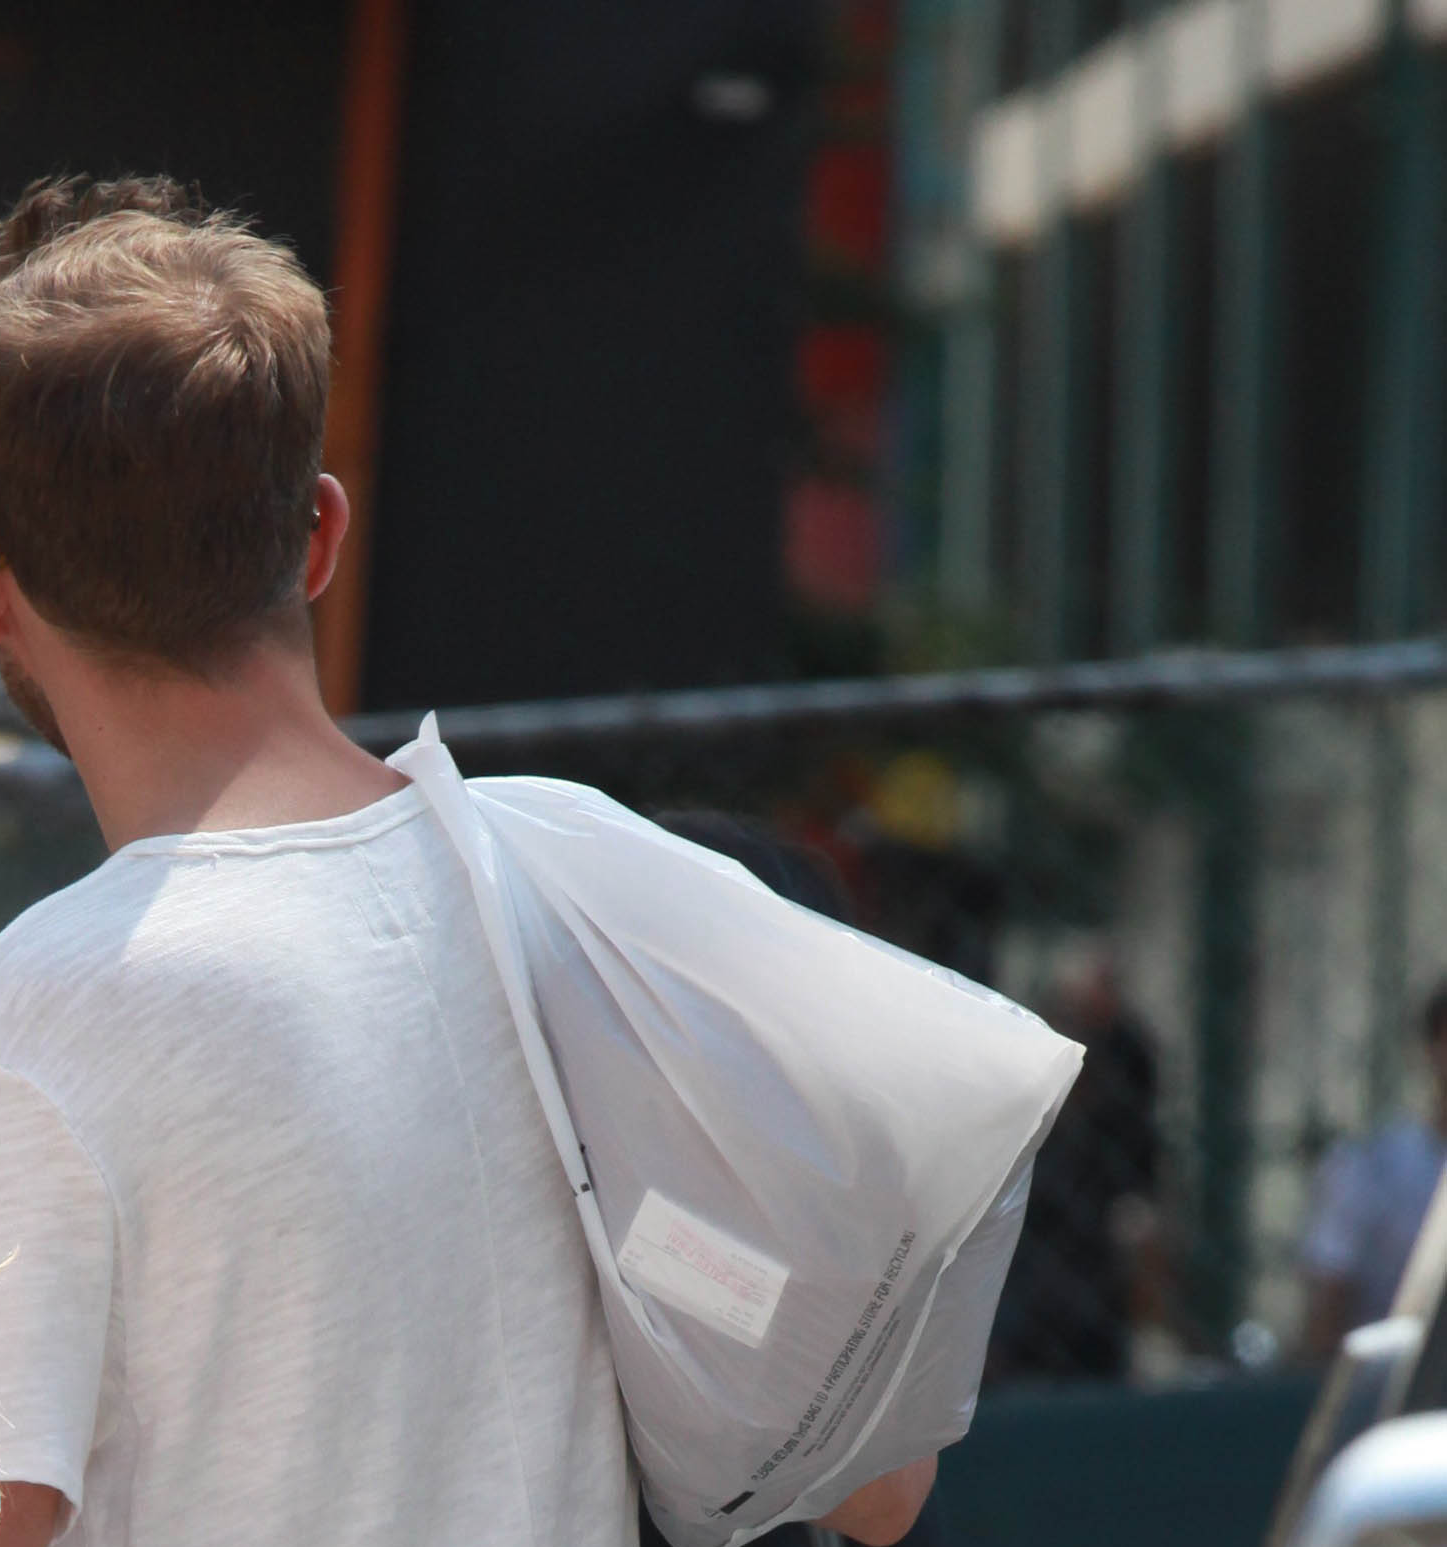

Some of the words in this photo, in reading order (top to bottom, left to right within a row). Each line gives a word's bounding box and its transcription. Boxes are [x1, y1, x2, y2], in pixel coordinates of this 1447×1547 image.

[803, 1402, 822, 1422] BAG
[815, 1391, 828, 1404] TO
[858, 1300, 883, 1330] STORE
[873, 1281, 893, 1301] FOR
[883, 1231, 916, 1282] RECYCLING
